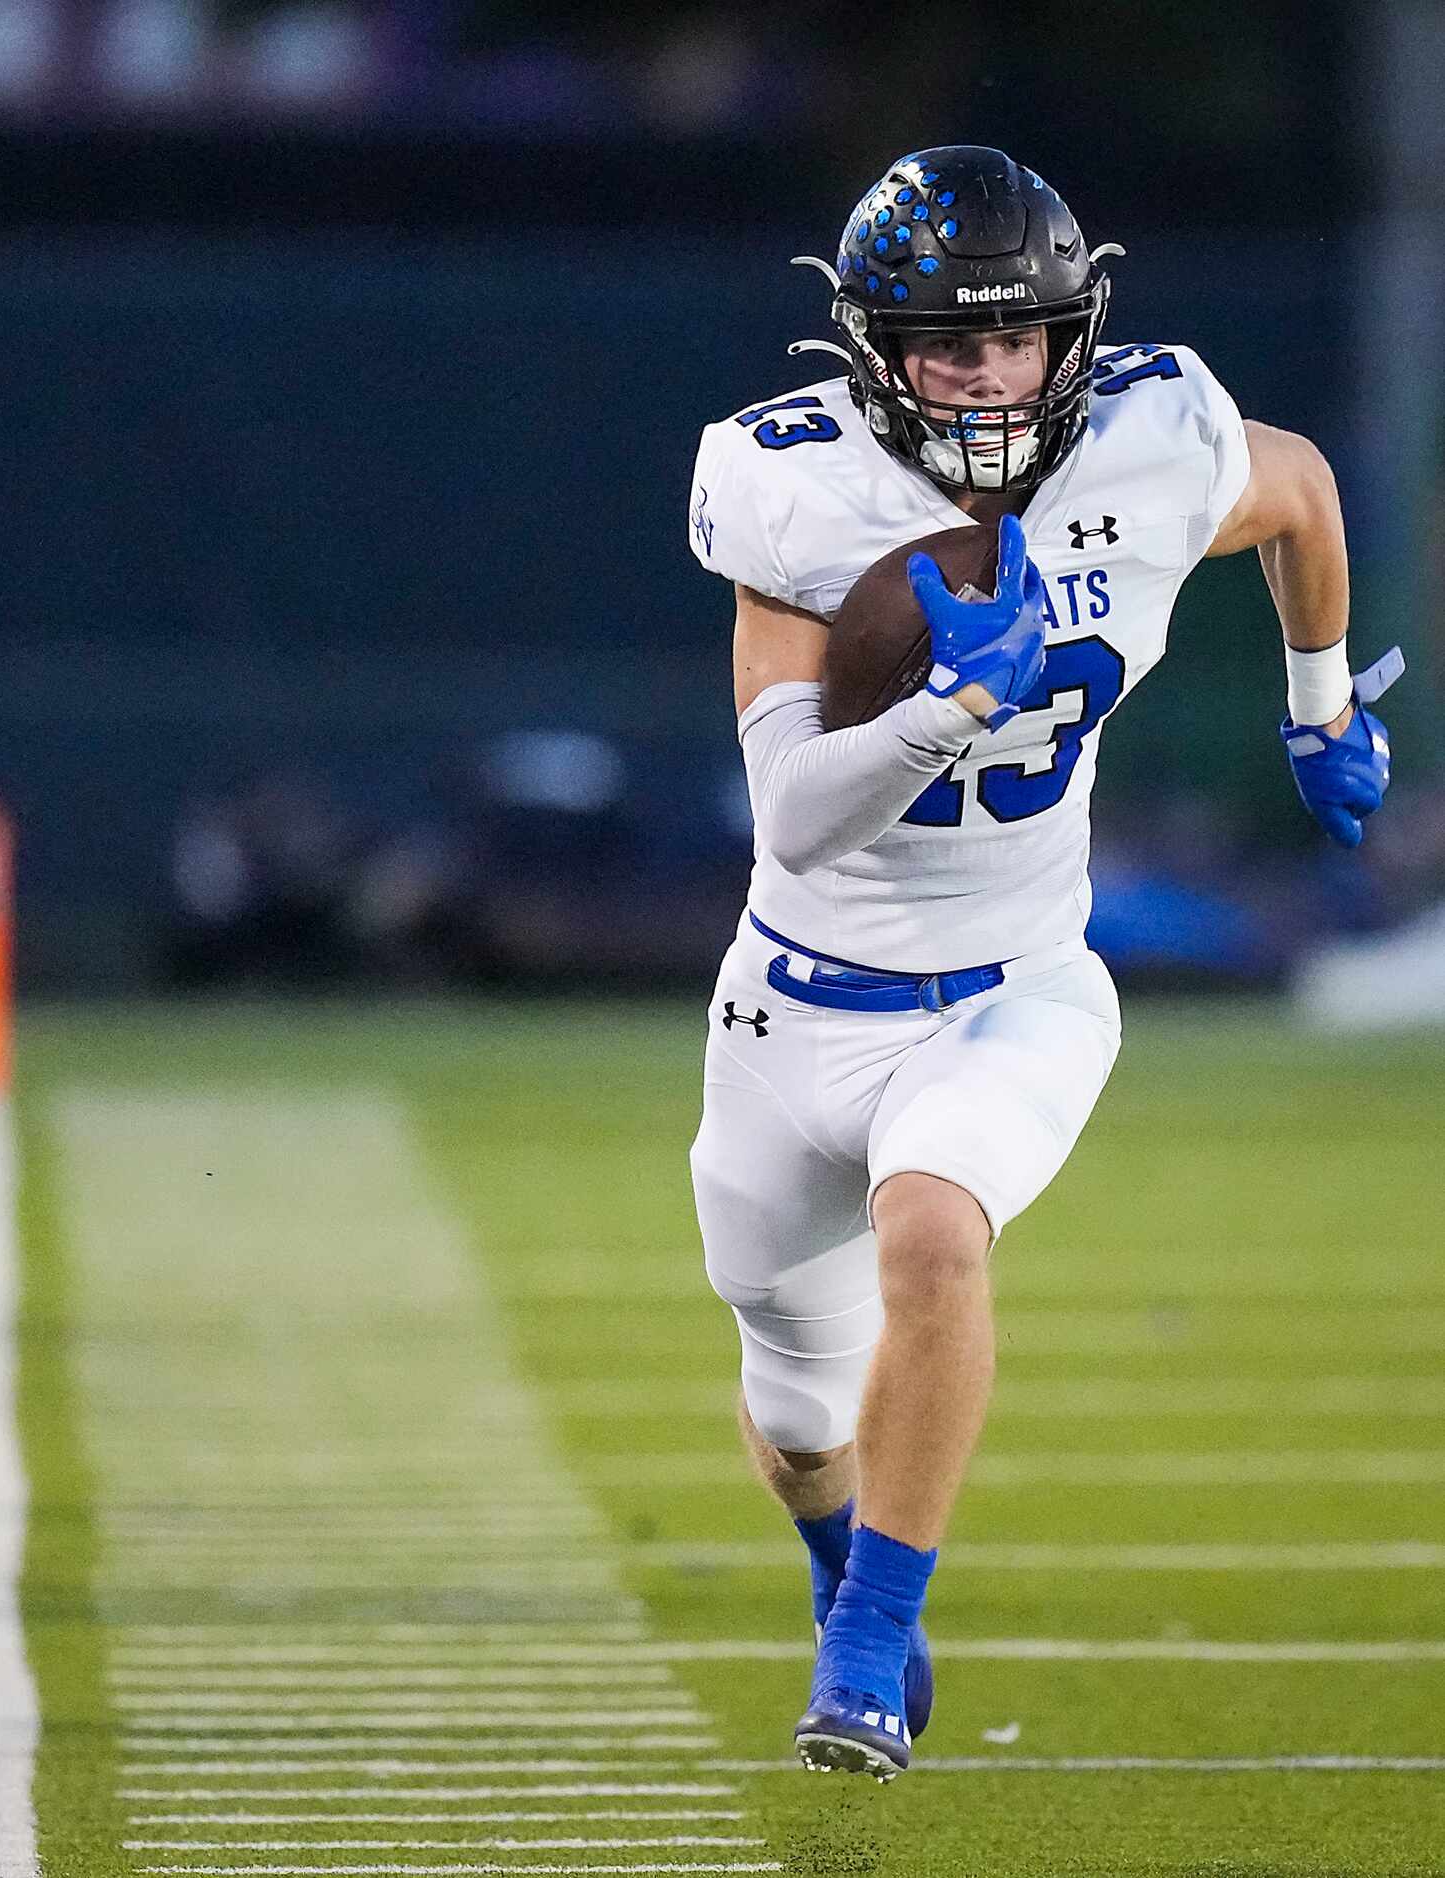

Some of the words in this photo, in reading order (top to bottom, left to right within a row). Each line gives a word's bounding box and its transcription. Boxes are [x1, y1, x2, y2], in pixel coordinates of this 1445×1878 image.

[957, 282, 1026, 304] Riddell
[1049, 342, 1083, 393] Riddel
[734, 396, 843, 450] 13
